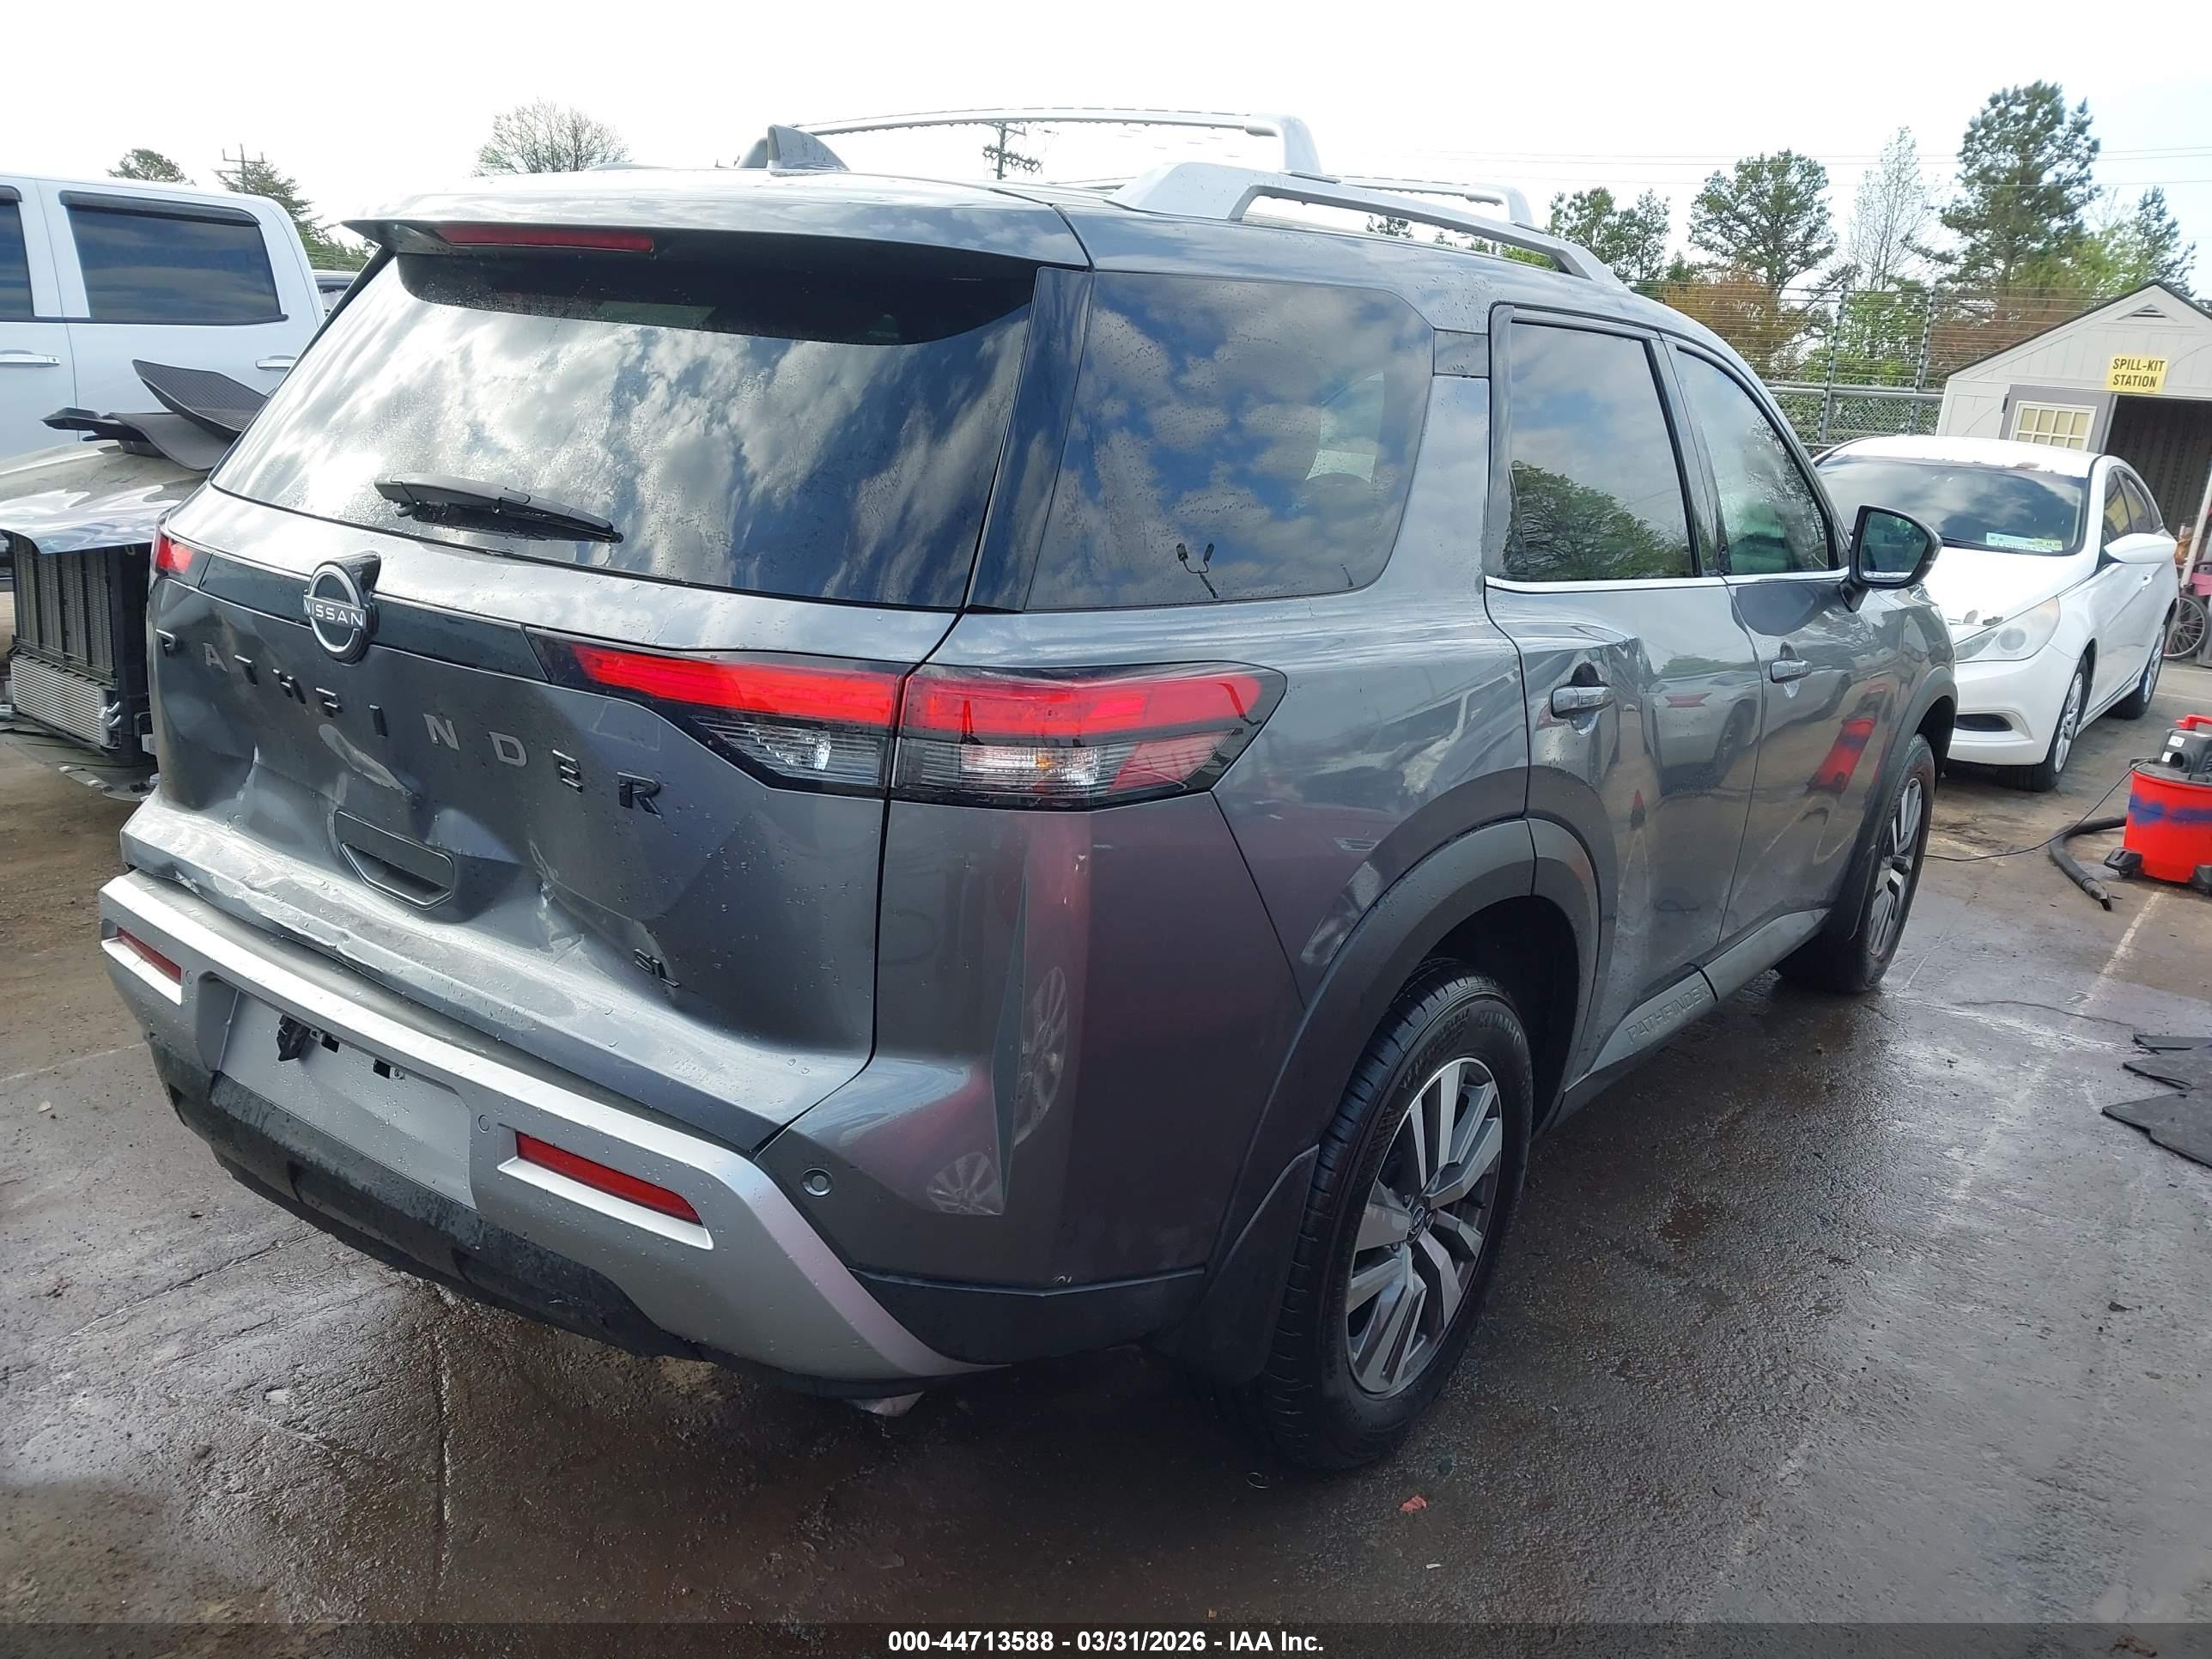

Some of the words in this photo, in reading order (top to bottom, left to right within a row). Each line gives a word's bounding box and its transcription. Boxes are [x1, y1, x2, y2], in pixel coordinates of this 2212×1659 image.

[2112, 358, 2166, 372] SPILL-KIT
[2112, 374, 2157, 387] STATION
[303, 599, 363, 627] NISSAN
[156, 629, 662, 817] PATHFINDER
[634, 948, 680, 988] SL
